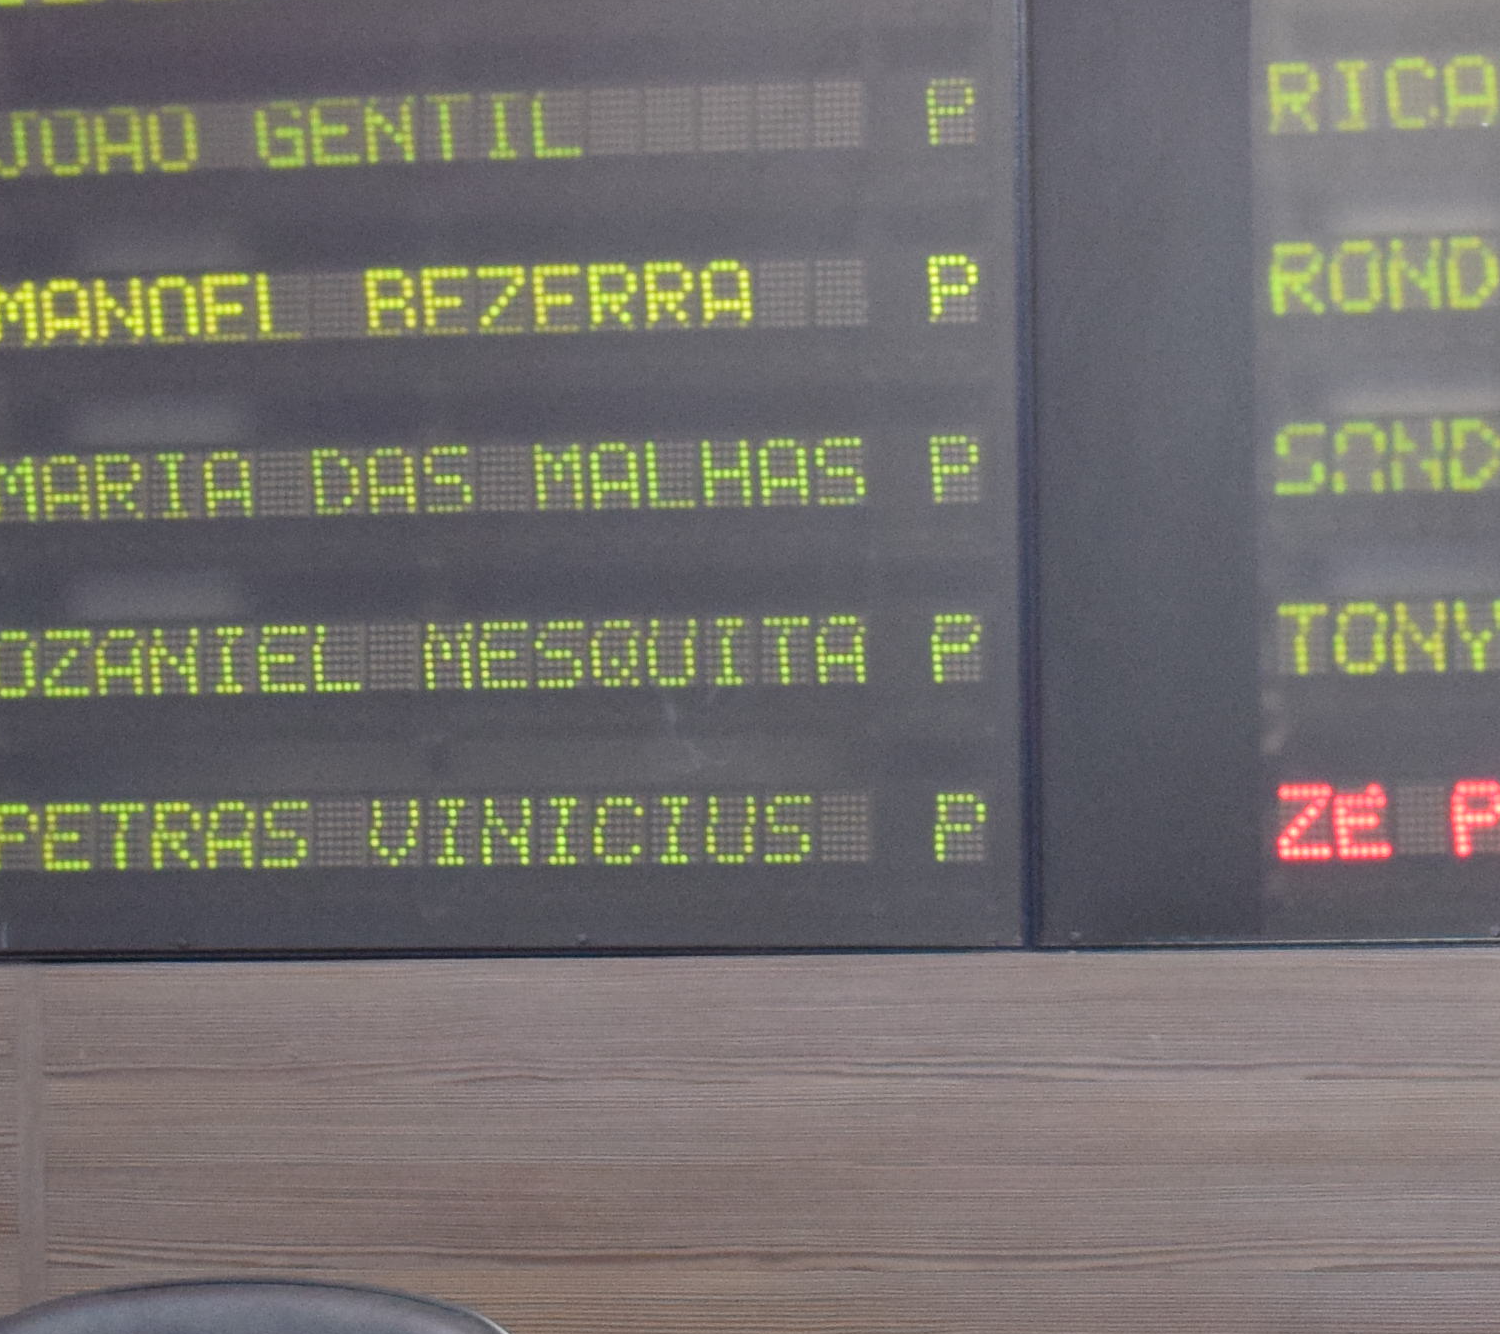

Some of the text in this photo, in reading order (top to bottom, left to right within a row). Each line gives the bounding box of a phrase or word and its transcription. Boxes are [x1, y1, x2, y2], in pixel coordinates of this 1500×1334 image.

[253, 94, 584, 170] GENTIL
[924, 80, 976, 146] P
[362, 258, 754, 335] BEZERRA
[927, 253, 980, 321] P
[309, 443, 475, 516] DAS
[531, 436, 868, 510] MALHAS
[928, 434, 981, 504] P
[421, 614, 868, 692] MESQUITA
[930, 612, 983, 684] P
[367, 794, 813, 868] VINICIUS
[935, 792, 988, 863] P
